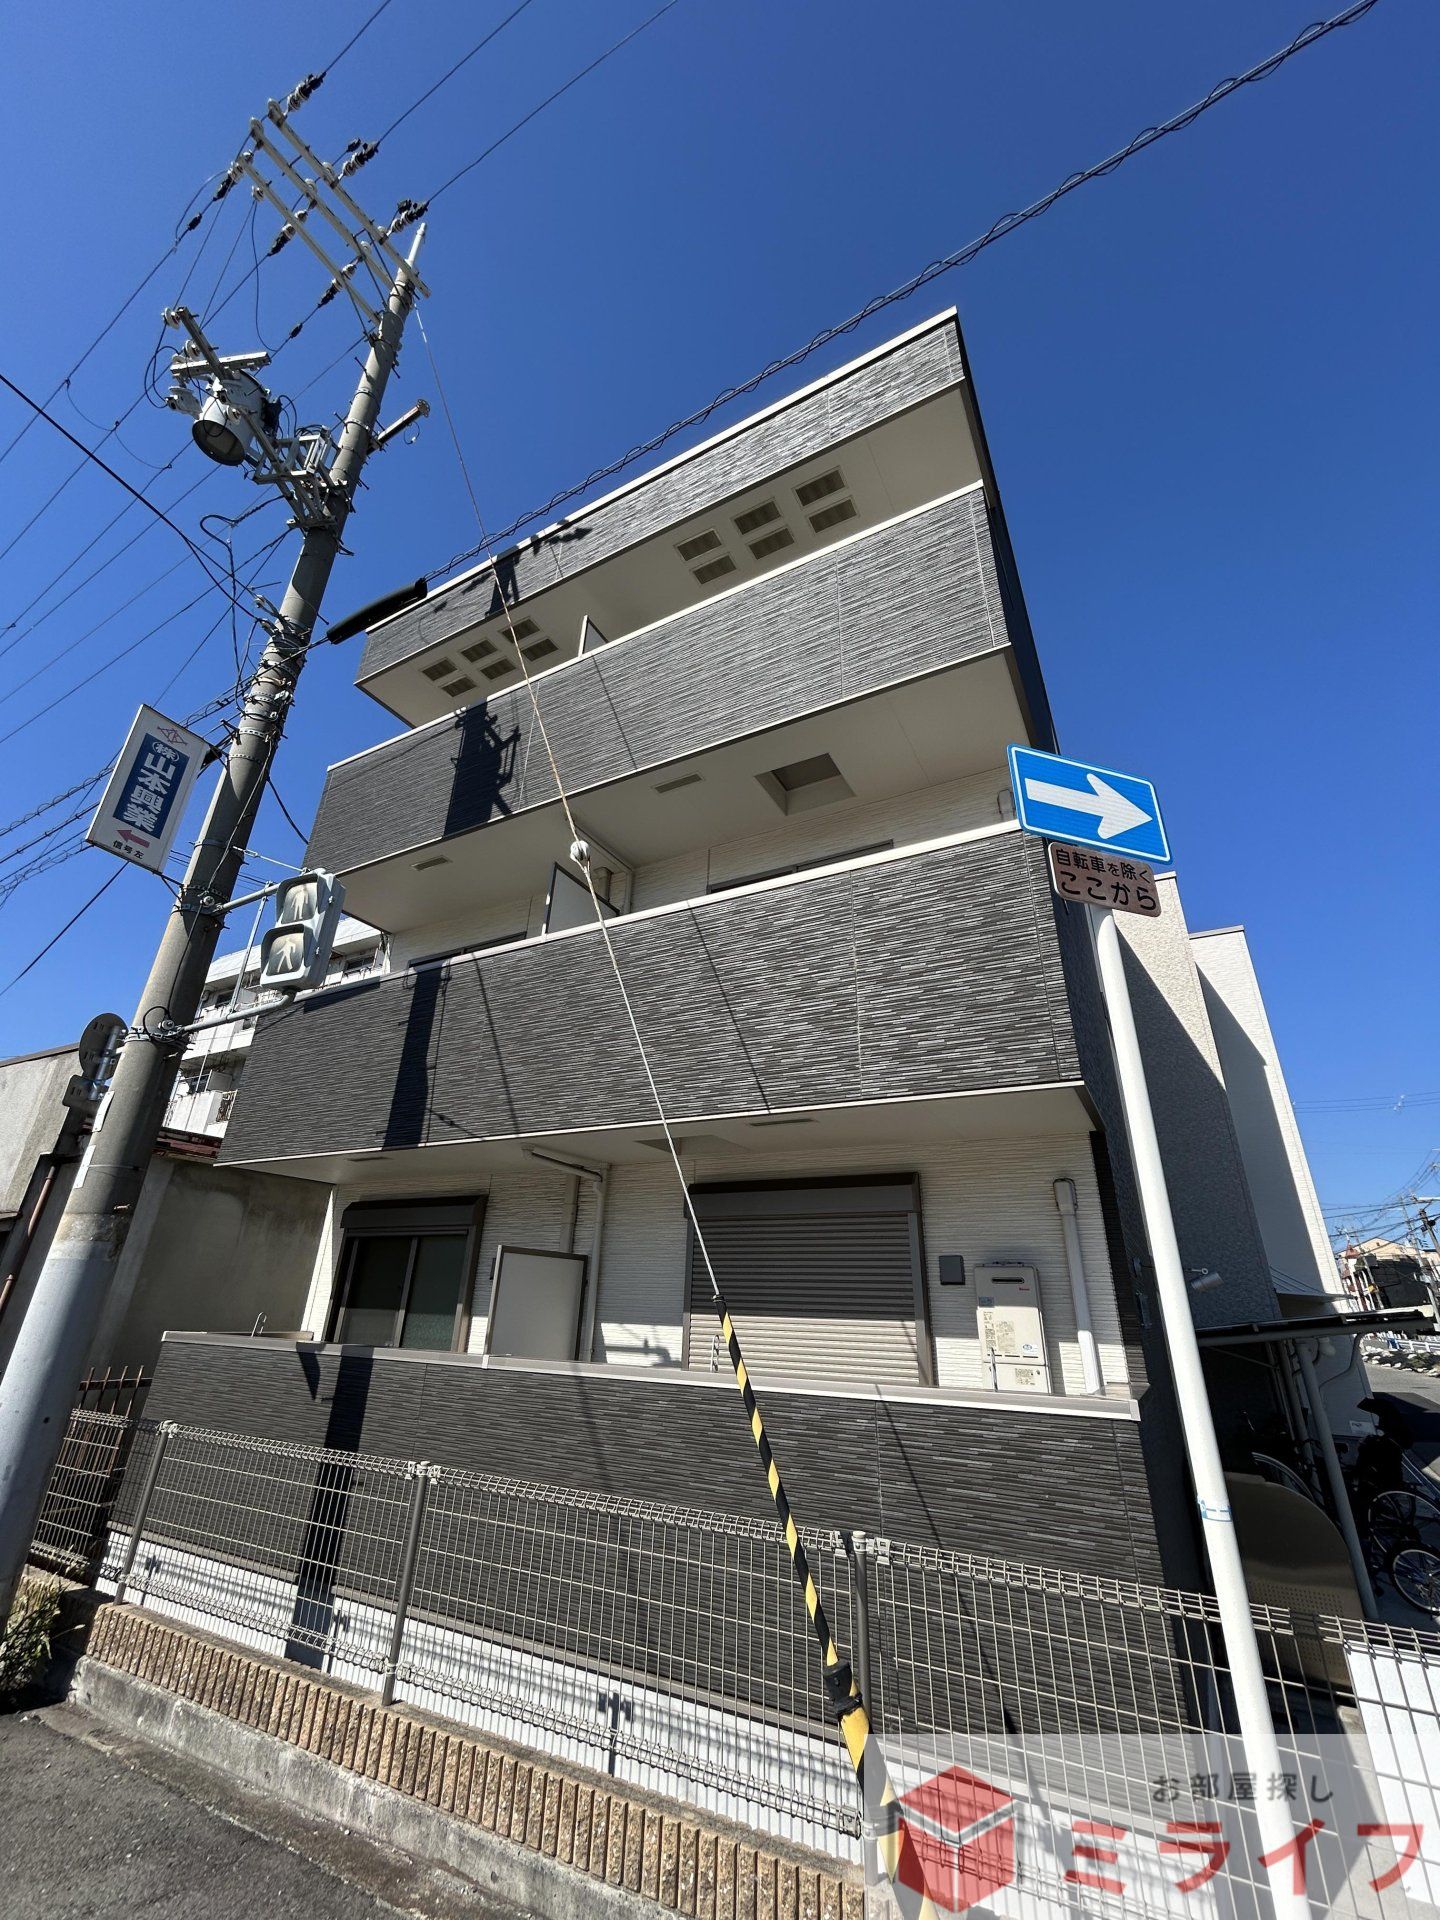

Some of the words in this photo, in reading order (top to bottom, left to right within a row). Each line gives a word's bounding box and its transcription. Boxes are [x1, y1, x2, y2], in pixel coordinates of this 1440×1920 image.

[1056, 849, 1151, 883] 自転車を除く
[1060, 870, 1156, 910] ここから
